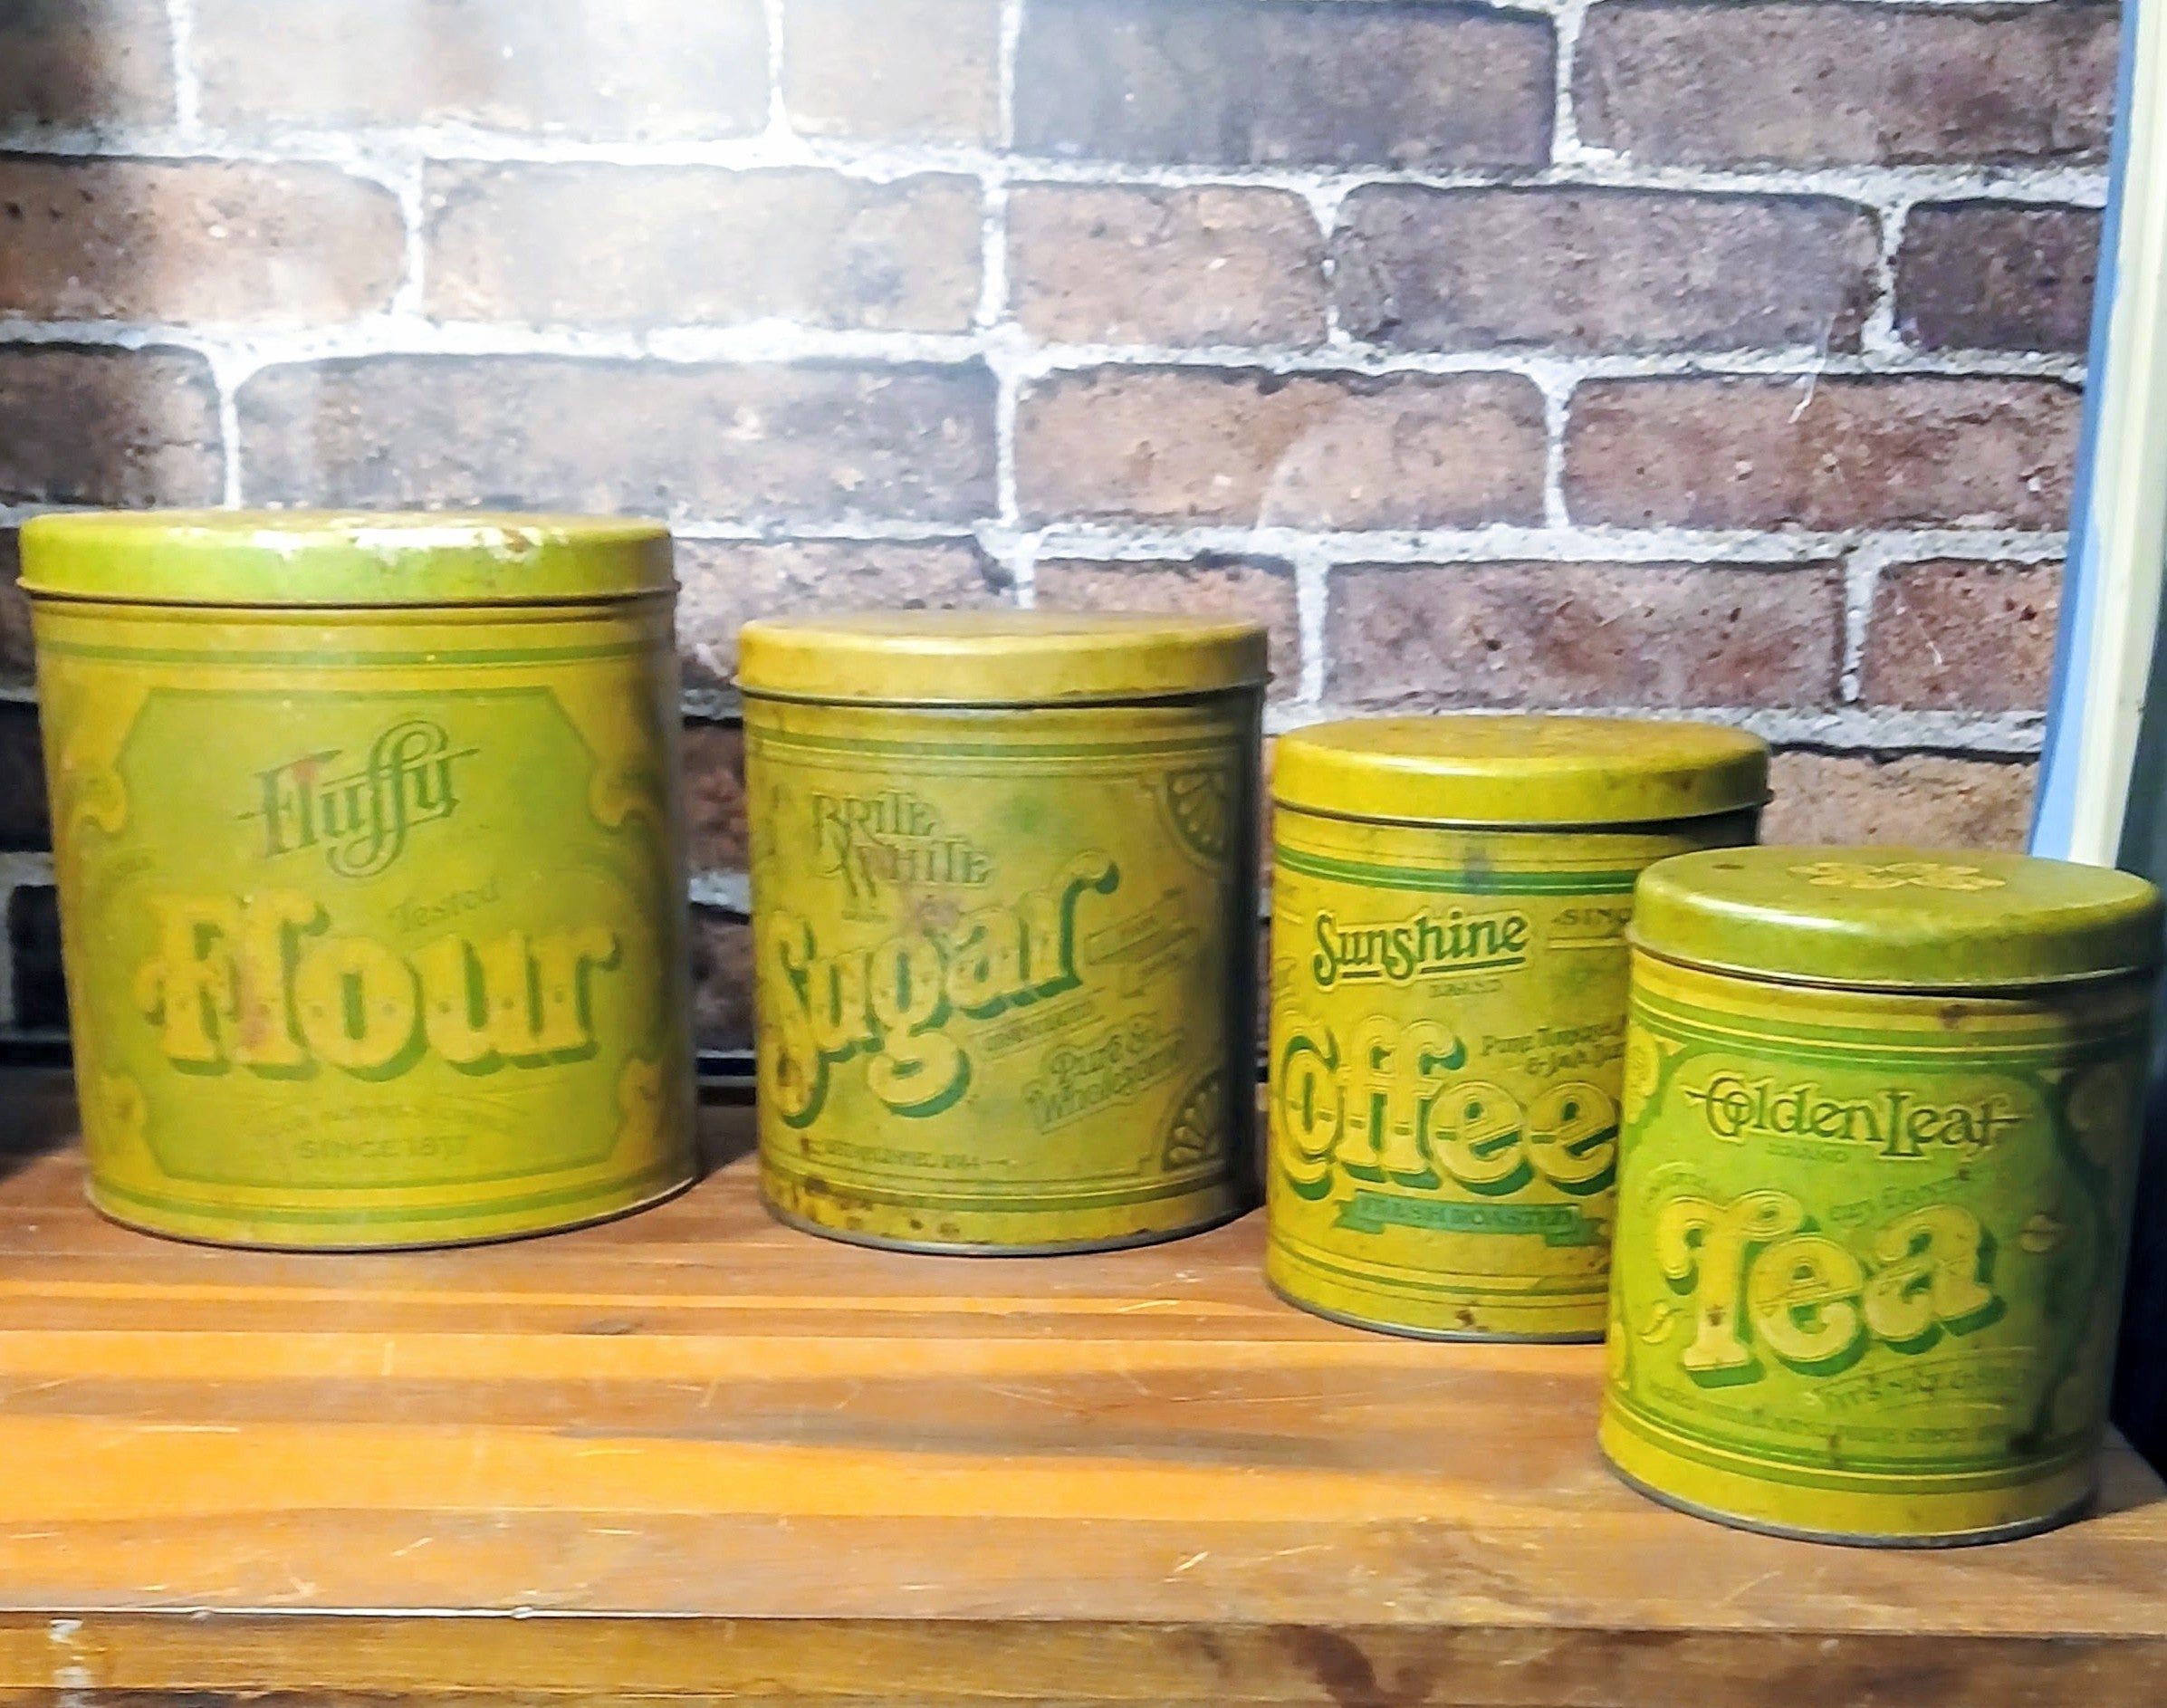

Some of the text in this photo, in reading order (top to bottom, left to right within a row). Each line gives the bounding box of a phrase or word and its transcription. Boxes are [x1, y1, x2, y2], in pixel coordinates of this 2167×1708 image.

[239, 720, 480, 877] Fluffy
[136, 892, 621, 1082] Flour
[766, 849, 1120, 1128] Sugar
[1313, 909, 1530, 986] Sunshine
[1275, 1010, 1621, 1201] Coffee
[1656, 1190, 2006, 1388] Tea
